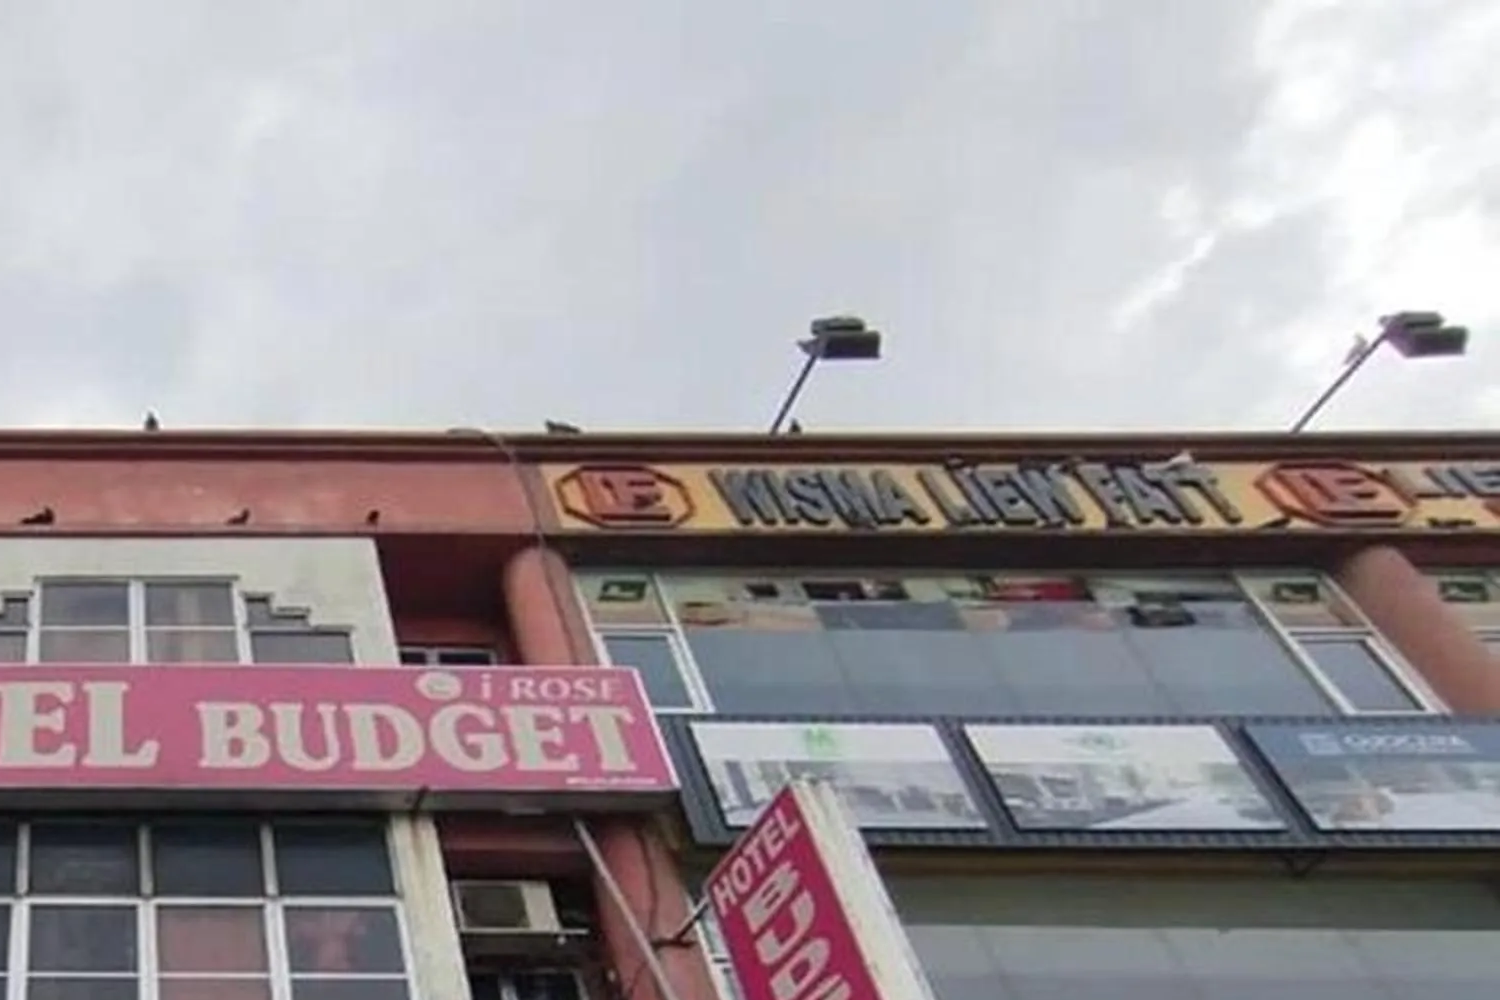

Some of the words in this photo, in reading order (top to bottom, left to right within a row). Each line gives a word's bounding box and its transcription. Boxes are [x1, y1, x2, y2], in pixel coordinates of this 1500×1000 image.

[708, 468, 930, 527] WISMA
[510, 676, 622, 700] ROSE
[196, 702, 638, 772] BUDGET
[711, 806, 801, 917] HOTEL
